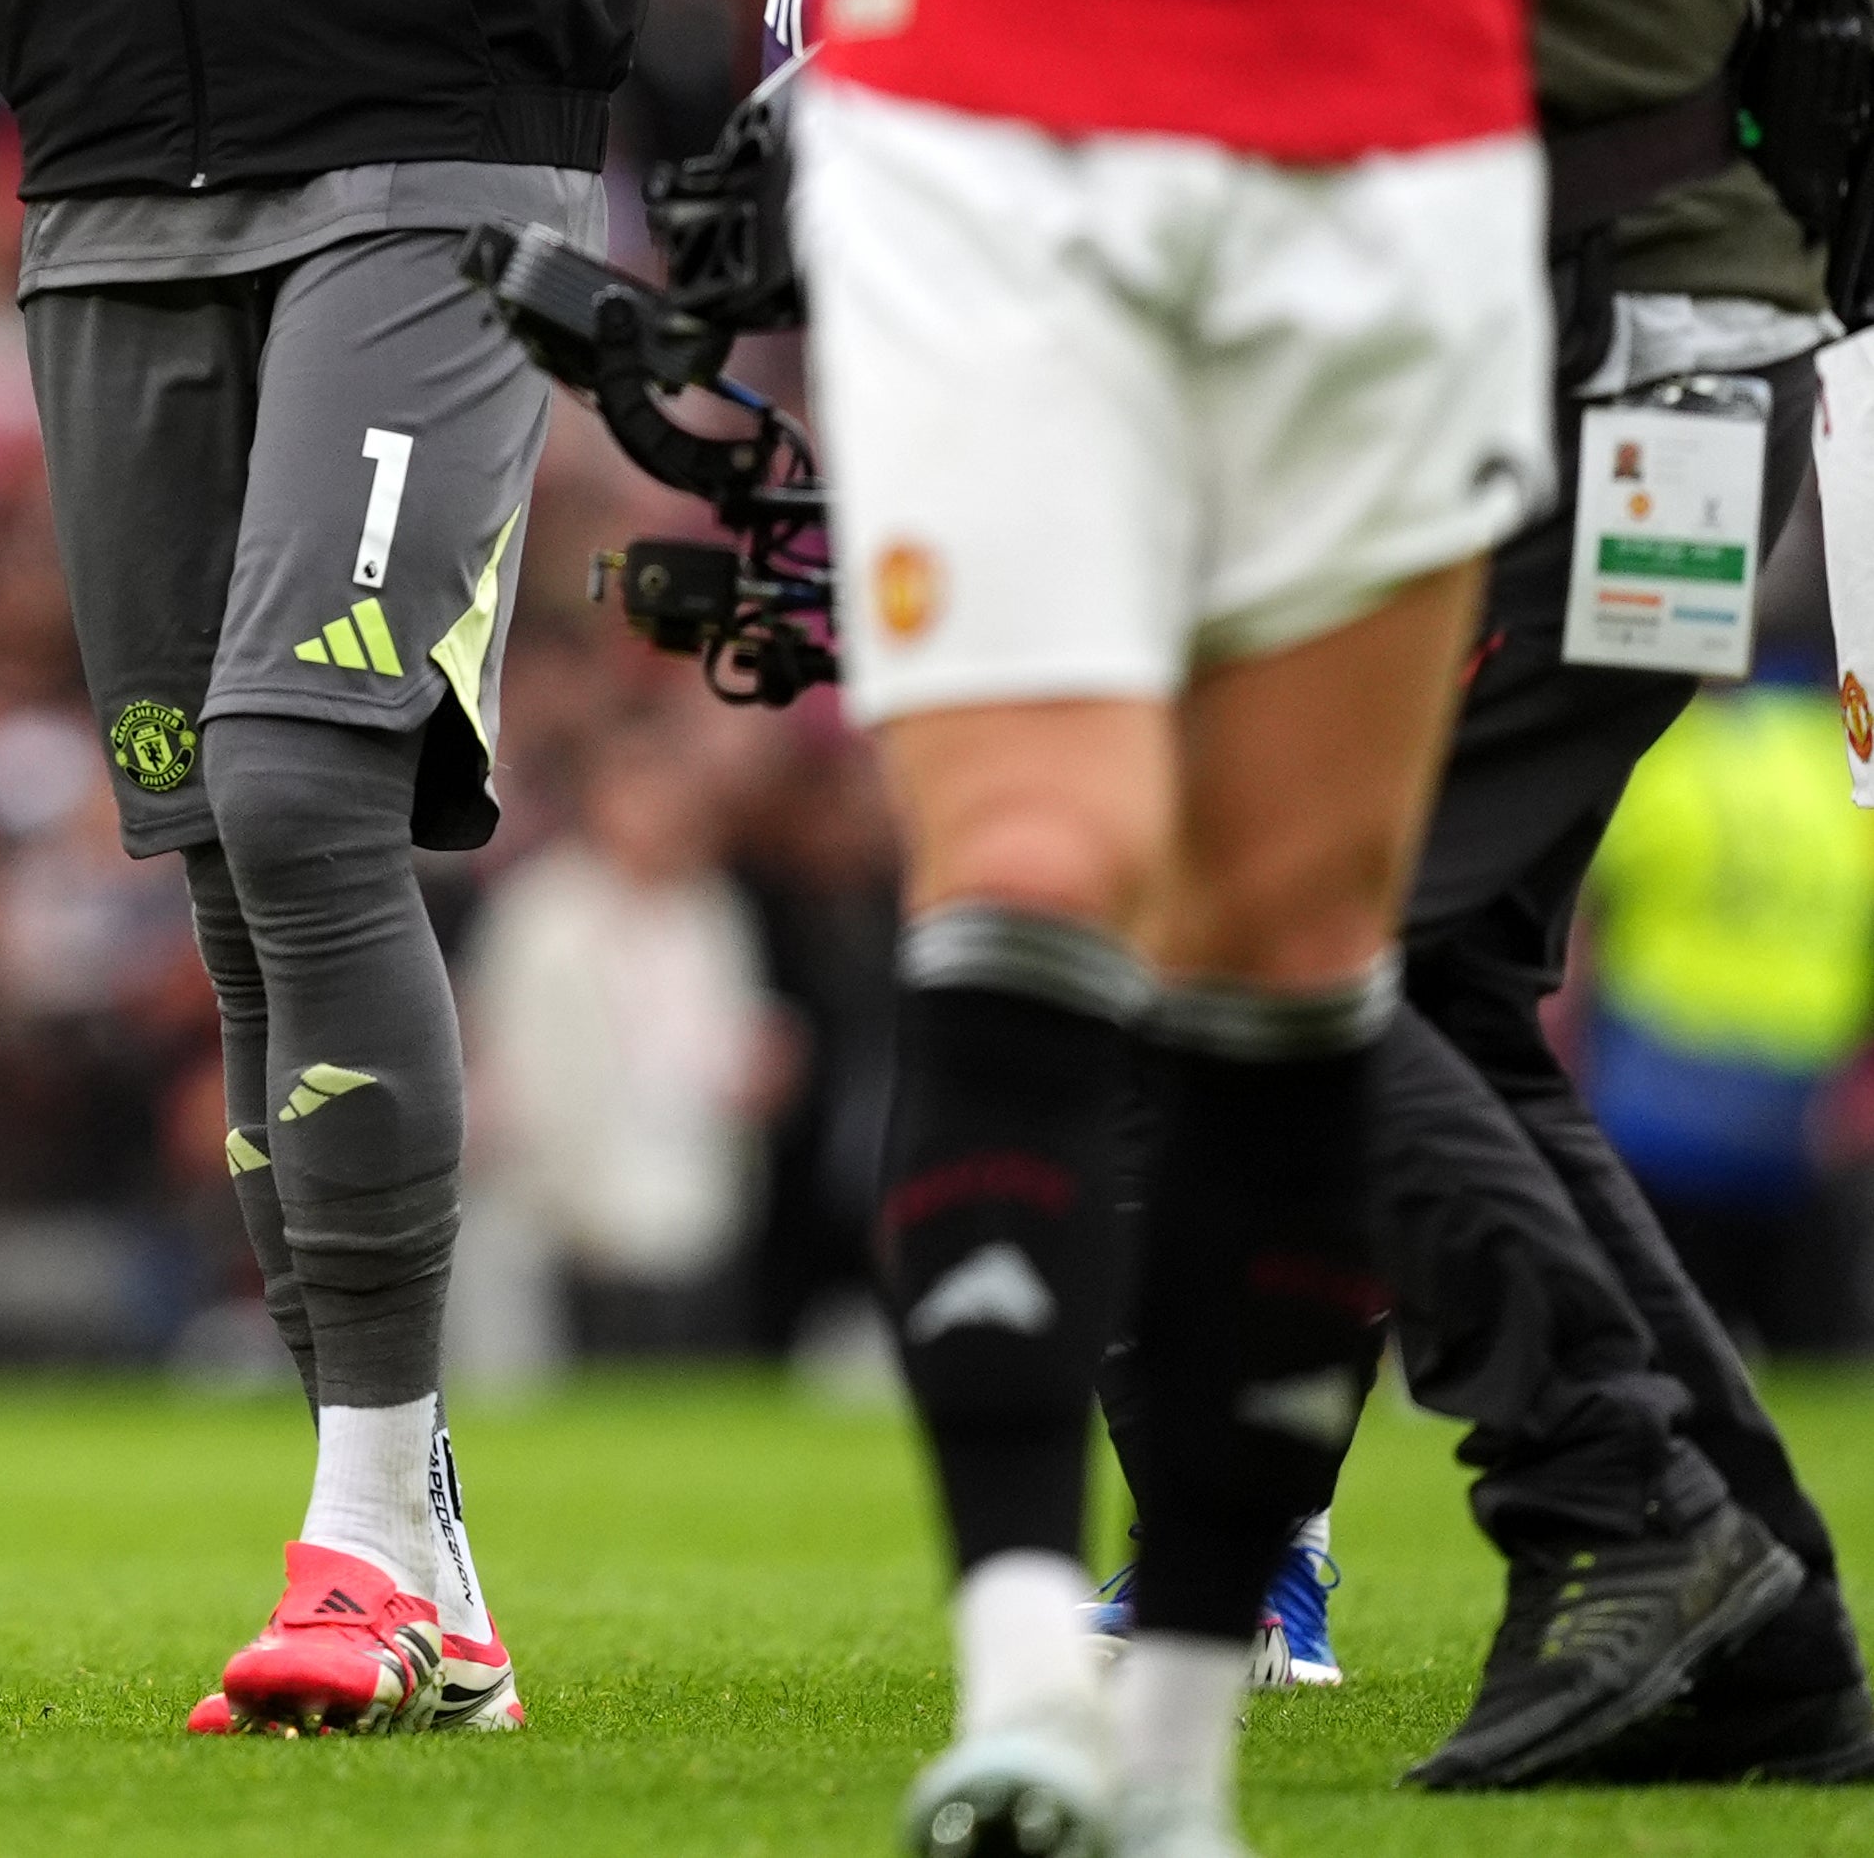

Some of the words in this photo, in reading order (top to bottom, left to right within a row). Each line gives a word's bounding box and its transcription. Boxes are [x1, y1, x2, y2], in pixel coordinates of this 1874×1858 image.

[353, 427, 413, 589] 1
[115, 705, 181, 745] MANCHESTER
[138, 762, 186, 786] UNITED
